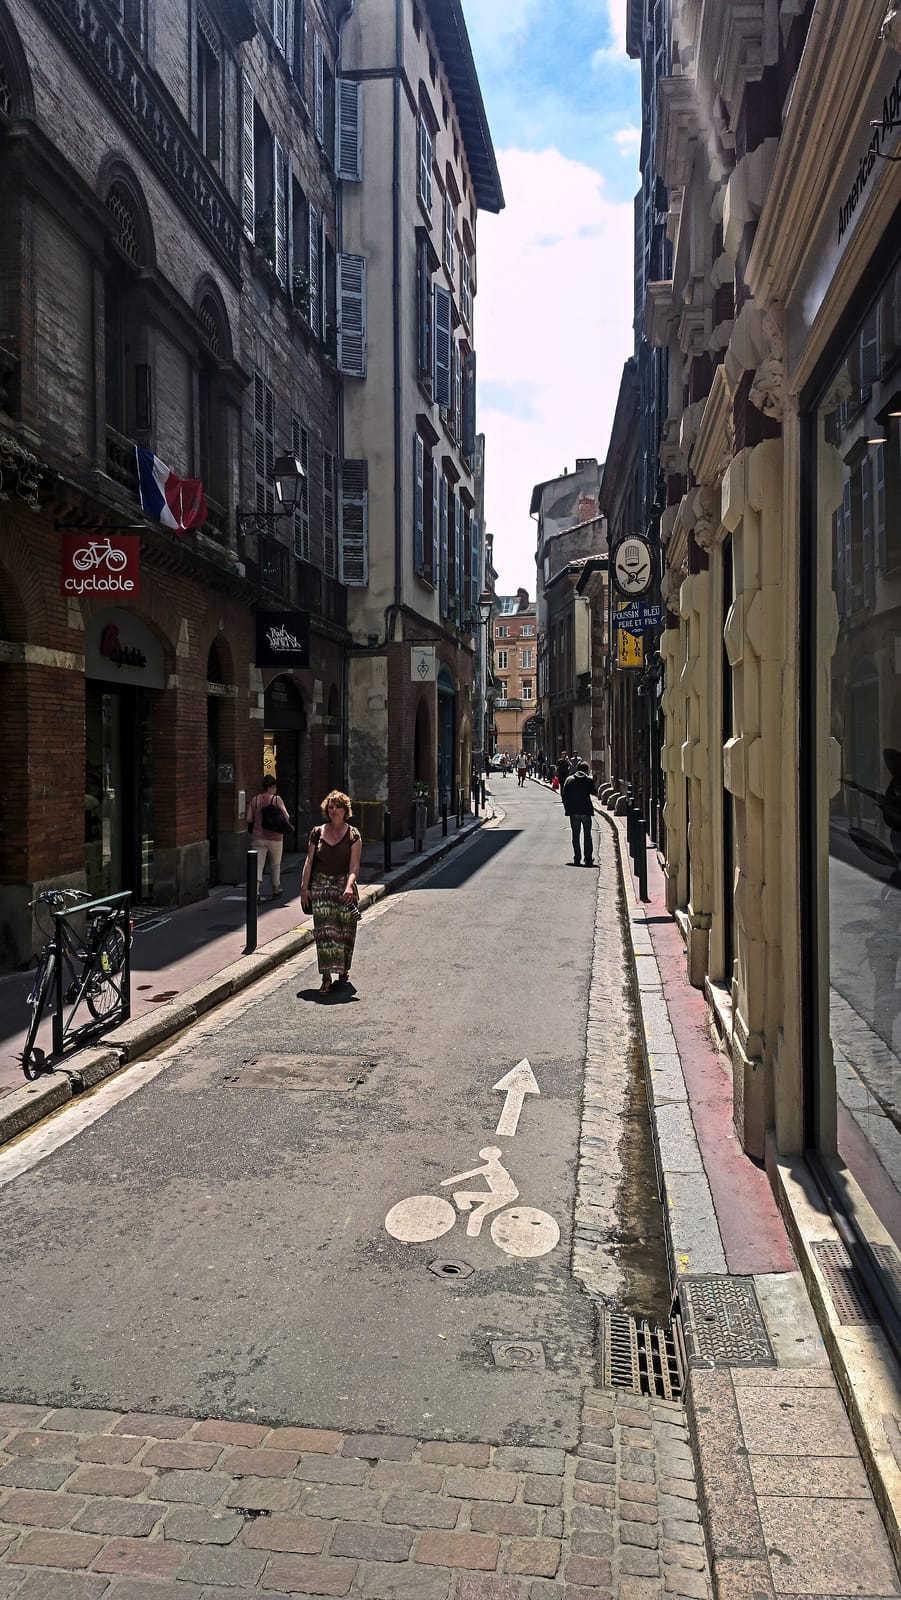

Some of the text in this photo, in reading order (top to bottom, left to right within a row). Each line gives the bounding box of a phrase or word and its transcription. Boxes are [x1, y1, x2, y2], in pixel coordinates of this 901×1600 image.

[838, 127, 880, 245] American
[64, 574, 135, 594] cyclable
[613, 607, 660, 620] POUSSIN BLEU
[632, 602, 640, 610] AU
